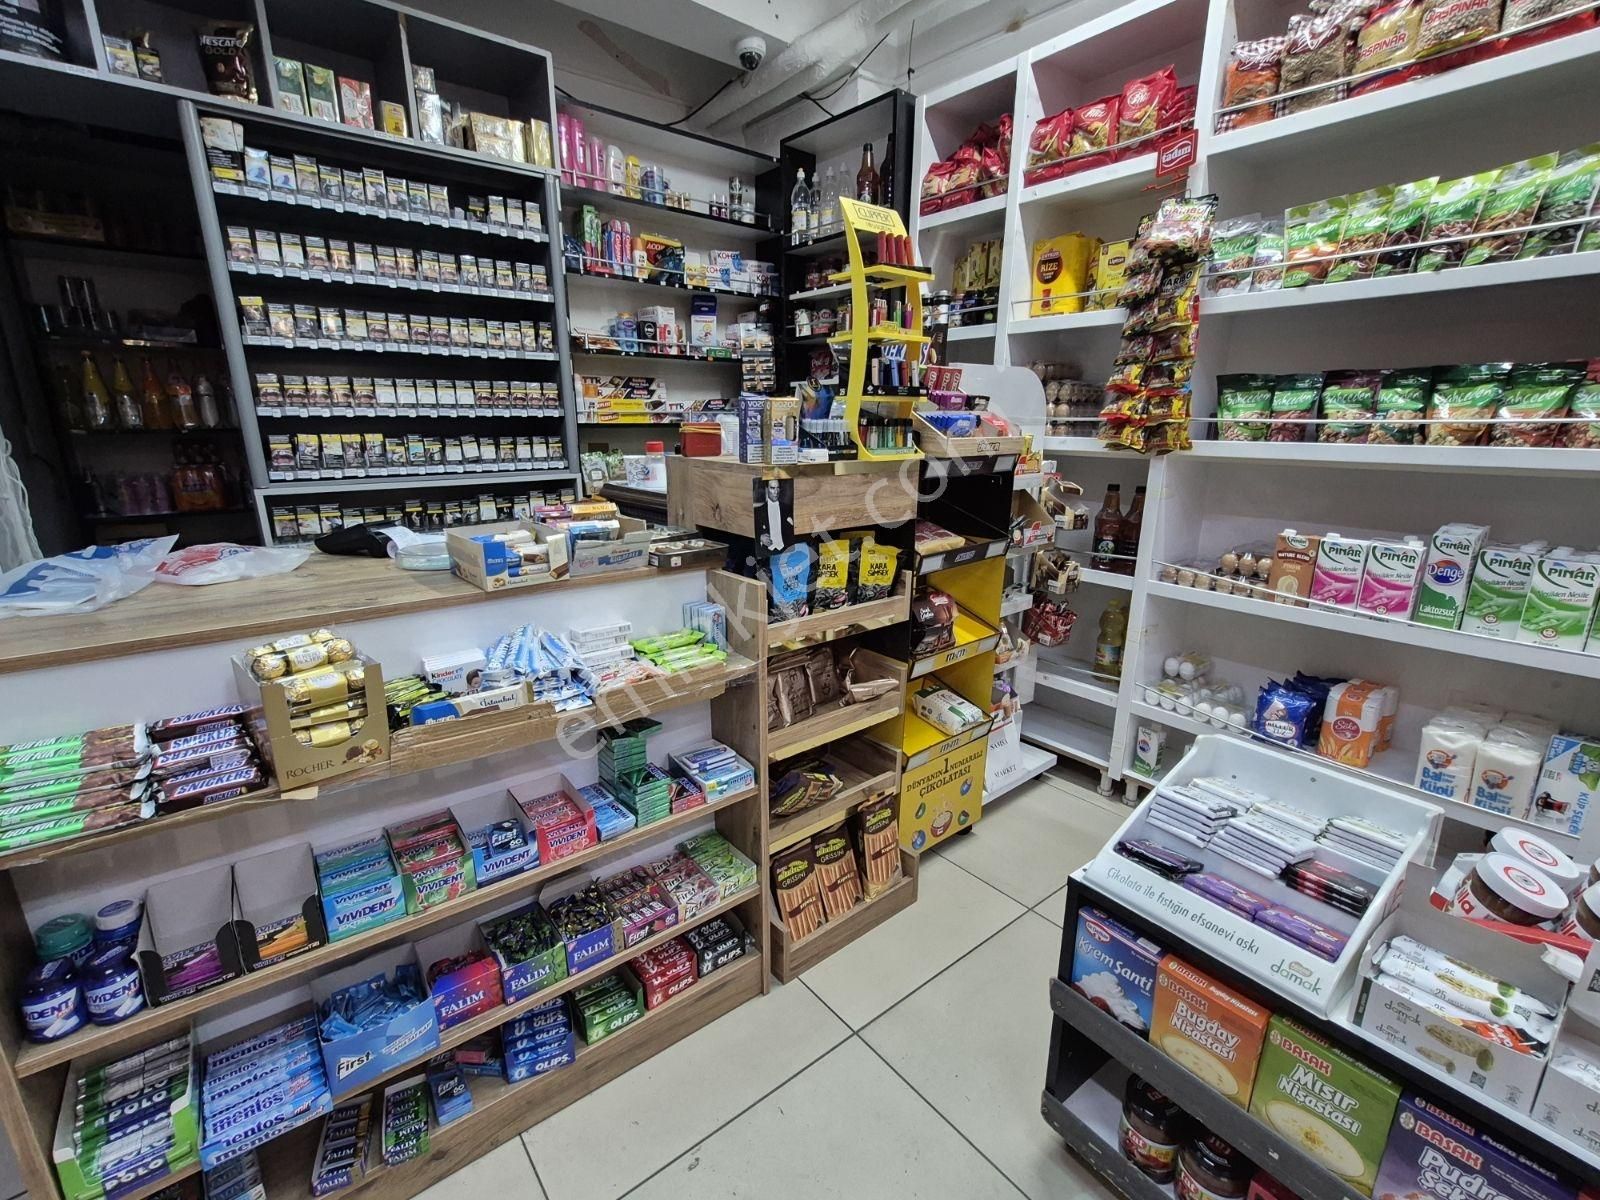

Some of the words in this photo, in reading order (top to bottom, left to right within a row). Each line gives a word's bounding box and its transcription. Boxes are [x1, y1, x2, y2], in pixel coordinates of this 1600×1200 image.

[857, 207, 890, 223] CLIPPER
[1328, 546, 1362, 558] PINAR
[1439, 541, 1471, 551] PINAR
[1380, 552, 1417, 564] PINAR
[1489, 556, 1532, 571] PINAR
[1428, 563, 1464, 581] Denge
[1547, 567, 1596, 582] PINAR
[1419, 603, 1456, 616] Laktozsuz
[431, 669, 456, 679] Kinder
[172, 704, 244, 724] SNICKERS
[171, 724, 241, 749] SNICKERS
[286, 759, 335, 780] ROCHER
[906, 768, 943, 793] DÜNYANIN
[942, 757, 950, 775] 1
[949, 750, 984, 771] NUMARALI
[1422, 767, 1443, 781] Bal
[176, 768, 256, 797] SNICKERS
[919, 765, 971, 797] ÇİKOLATASI
[1420, 778, 1454, 798] Küpü
[1477, 786, 1497, 800] Bal
[491, 828, 517, 845] First
[509, 838, 522, 847] 60
[549, 828, 587, 848] VIVIDENT
[330, 859, 383, 881] VIVIDENT
[483, 848, 531, 873] VIVIDENT
[654, 859, 672, 874] First
[418, 872, 465, 895] VIVIDENT
[664, 875, 683, 890] First
[724, 880, 740, 896] First
[335, 883, 390, 906] VIVIDENT
[677, 887, 696, 904] First
[336, 897, 396, 925] VIVIDENT
[685, 902, 702, 919] First
[1106, 866, 1144, 896] Çikolata
[1143, 883, 1156, 901] ile
[1156, 890, 1189, 920] fıstığın
[1190, 911, 1236, 943] efsanevi
[1236, 934, 1260, 956] aşkı
[628, 927, 650, 944] First
[574, 938, 610, 963] FALIM
[717, 947, 742, 965] OLIPS
[1078, 937, 1115, 969] Krem
[510, 964, 550, 991] FALIM
[668, 975, 694, 996] OLIPS
[1271, 957, 1323, 997] damak
[441, 990, 484, 1018] FALIM
[1384, 999, 1422, 1027] damak
[610, 1009, 641, 1030] OLIPS
[1375, 1023, 1407, 1046] damak
[211, 1037, 278, 1068] mentos
[208, 1060, 258, 1087] mentos
[336, 1051, 373, 1080] First
[535, 1055, 571, 1072] OLIPS
[437, 1076, 460, 1095] First
[453, 1084, 466, 1095] 60
[108, 1090, 168, 1122] POLO
[389, 1113, 416, 1128] FALIM
[214, 1122, 297, 1165] mentos
[326, 1147, 355, 1163] FALIM
[386, 1148, 418, 1165] FALIM
[105, 1156, 166, 1191] POLO
[317, 1175, 349, 1192] FALIM
